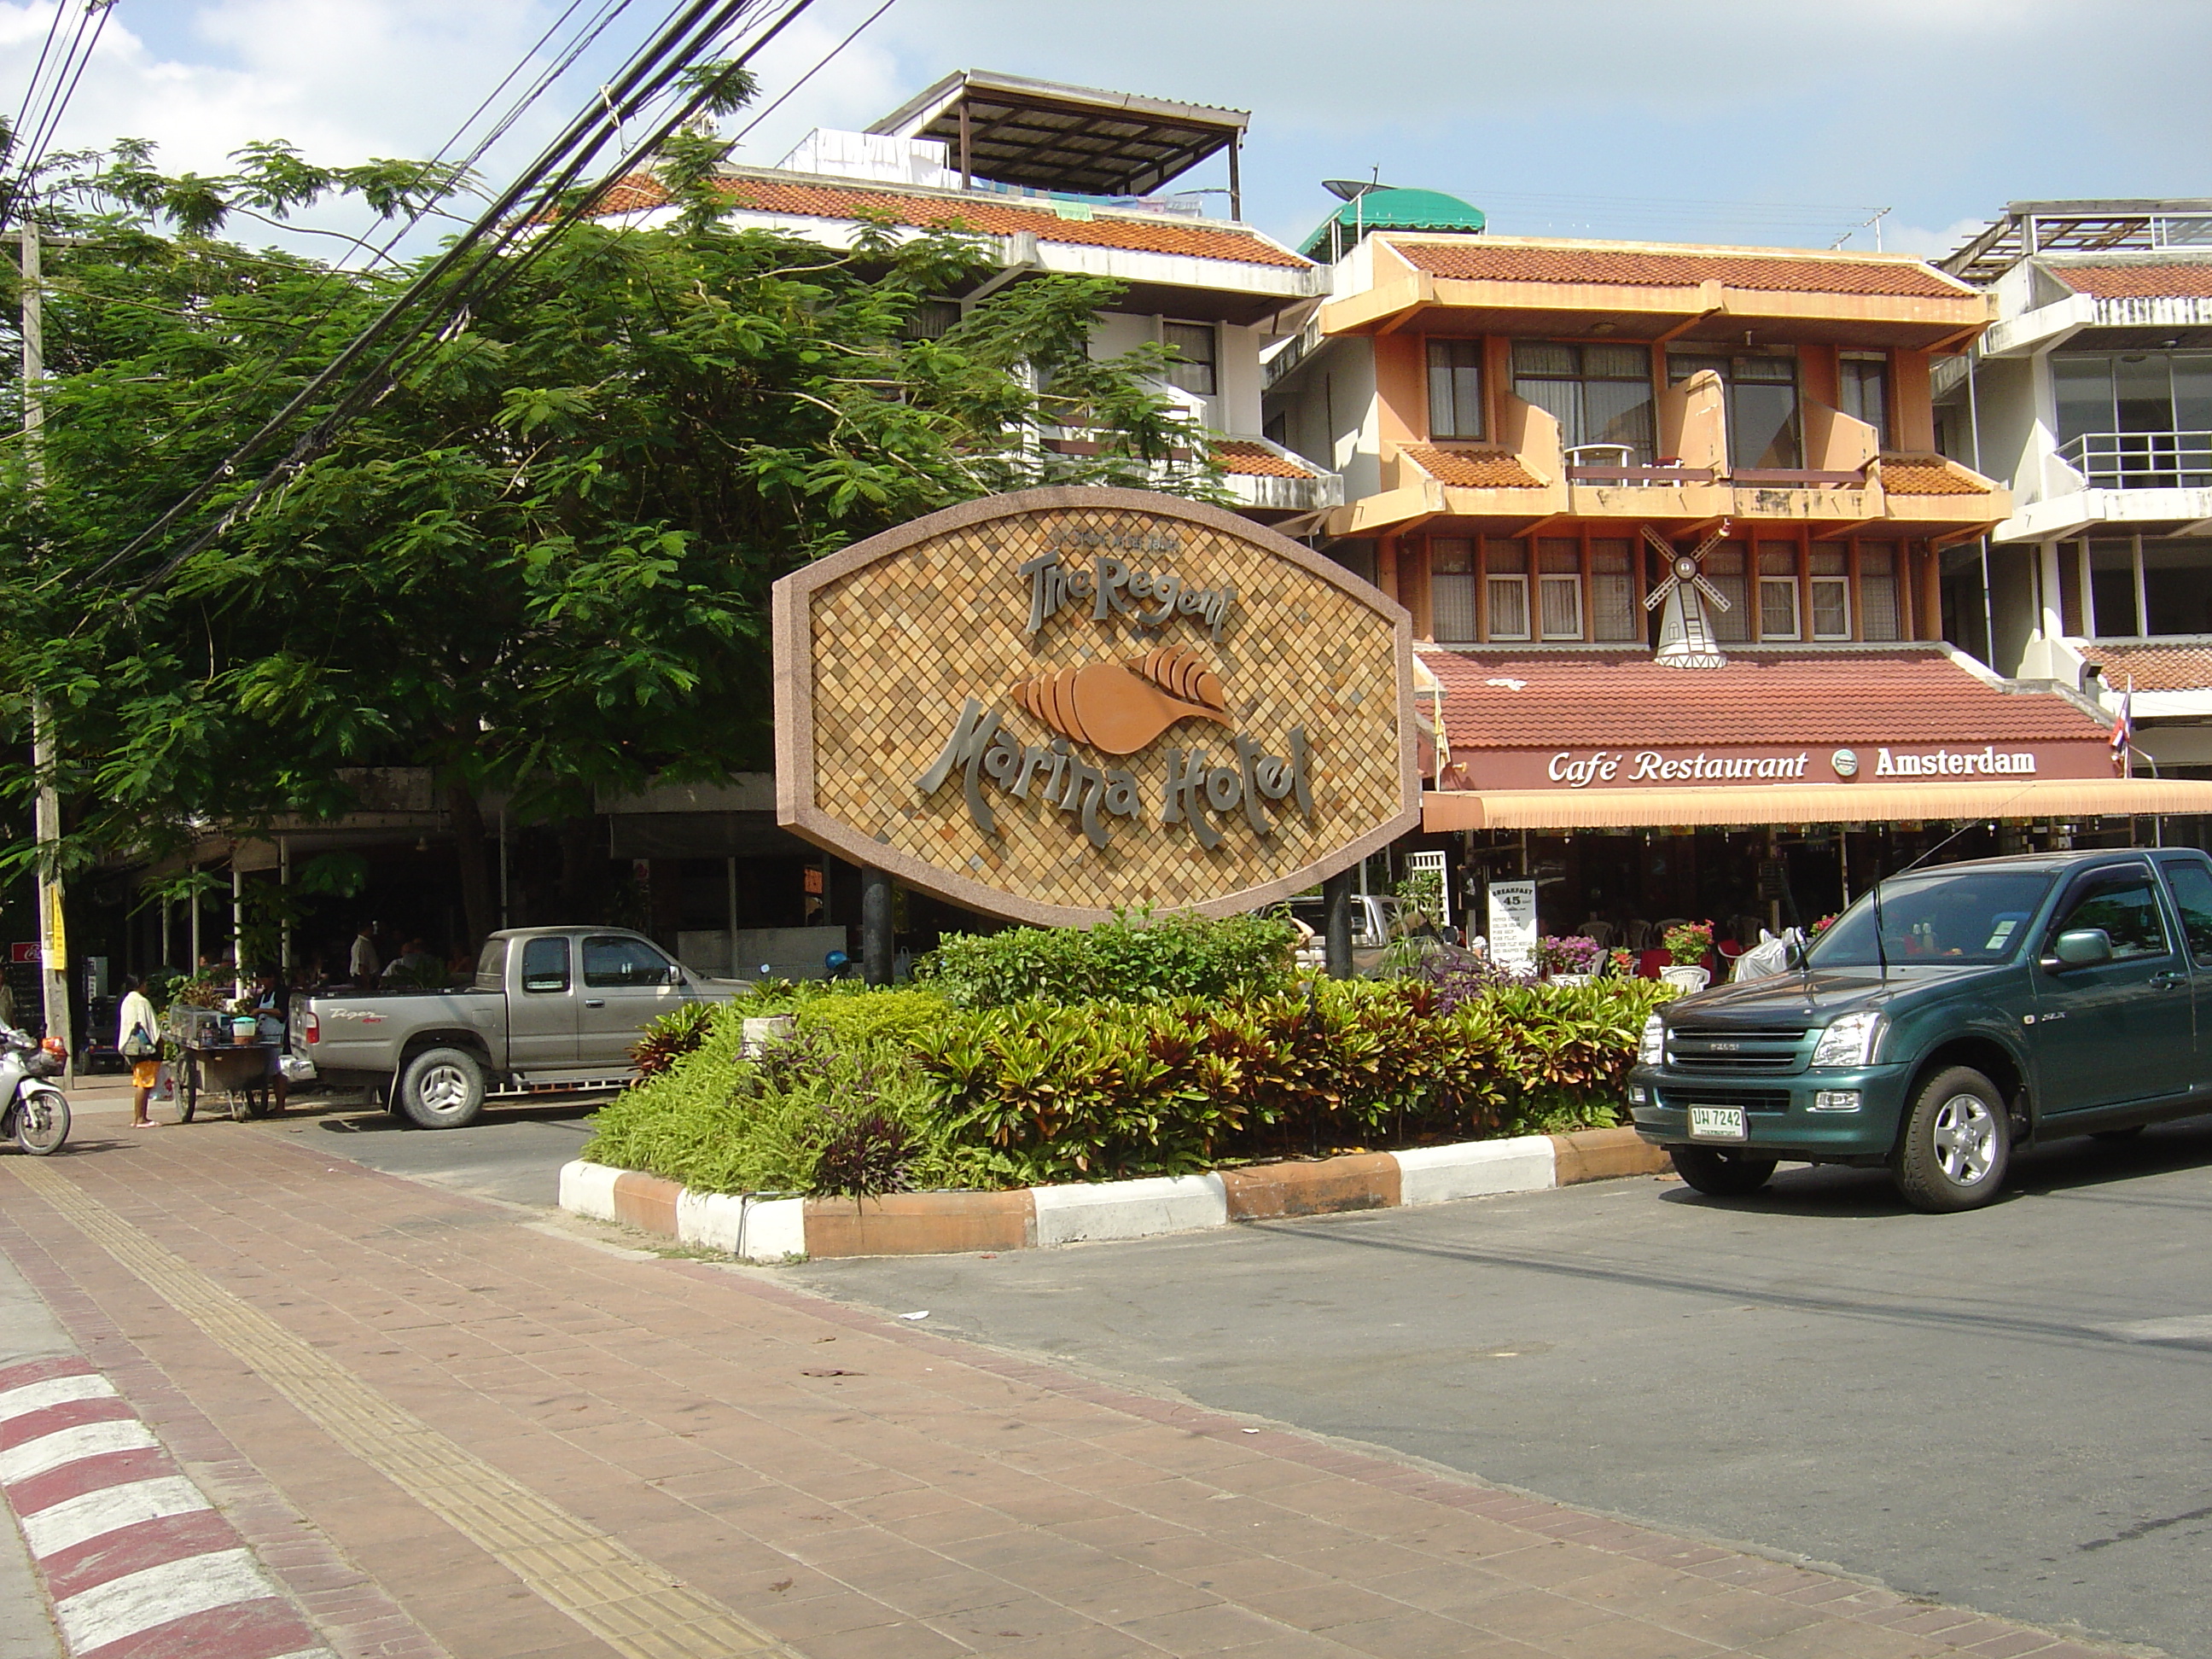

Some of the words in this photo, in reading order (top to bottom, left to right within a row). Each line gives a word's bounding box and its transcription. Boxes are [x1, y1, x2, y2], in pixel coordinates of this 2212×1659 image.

[1019, 547, 1093, 634] The
[1091, 556, 1238, 643] Regent
[1628, 751, 1808, 780] Restaurant
[1876, 747, 2037, 777] Amsterdam
[916, 697, 1141, 849] Marina
[1160, 723, 1315, 850] Hotel
[1493, 888, 1533, 897] BREAKFAST
[1504, 896, 1521, 905] 45
[329, 1008, 388, 1021] Tiger
[1713, 1110, 1741, 1126] 7242
